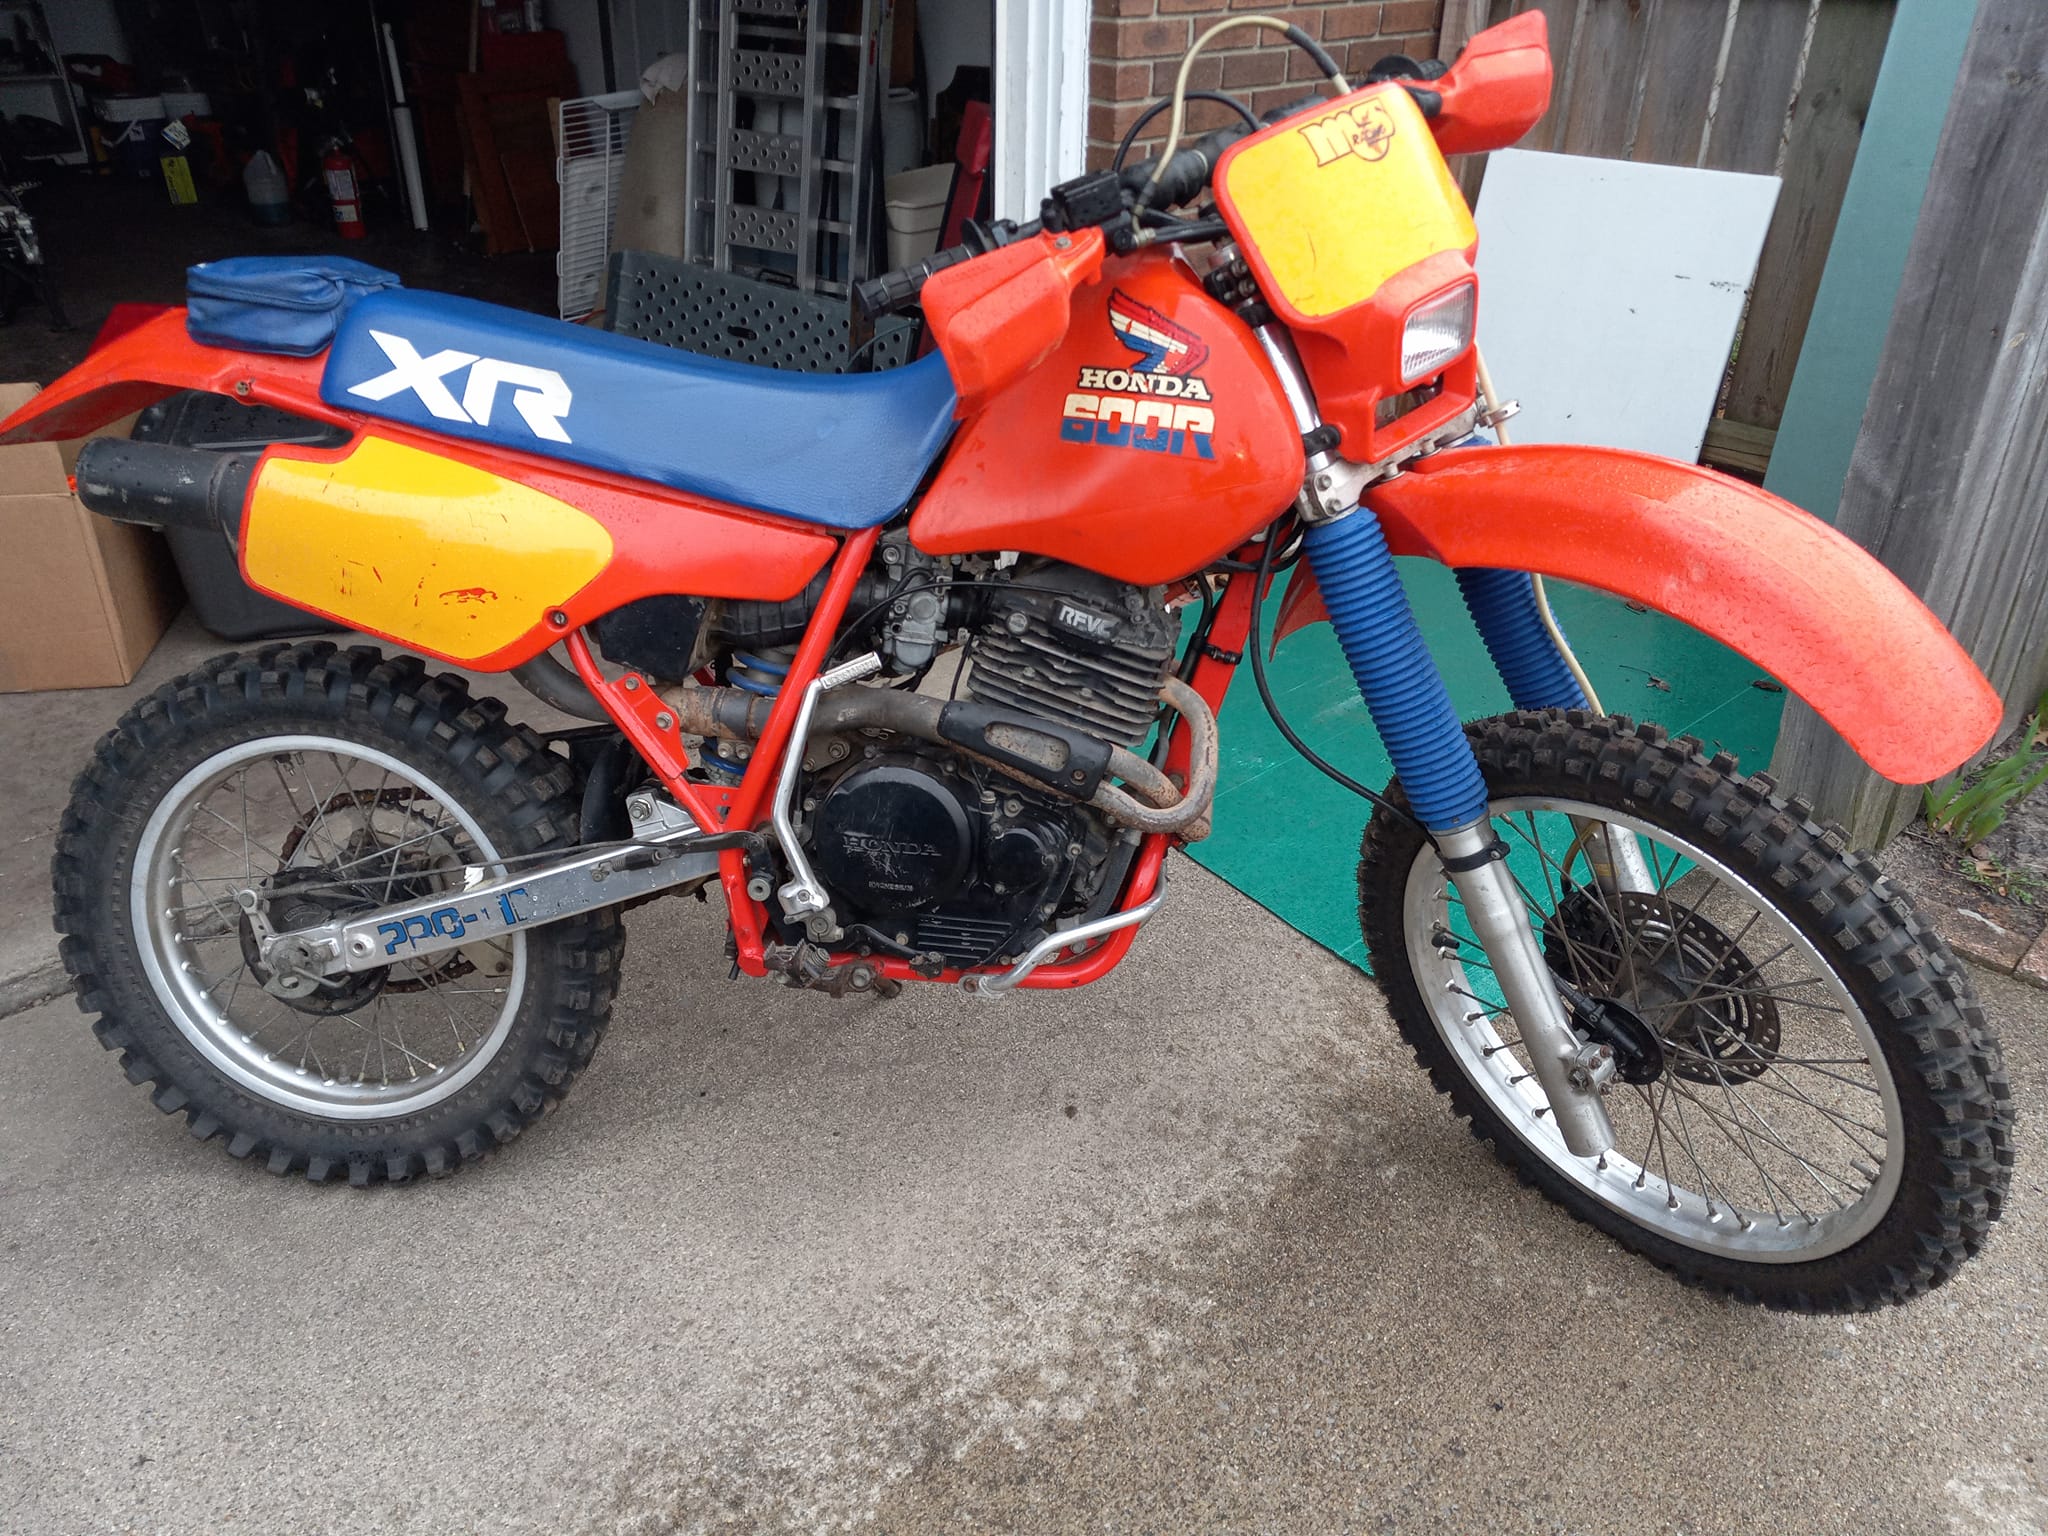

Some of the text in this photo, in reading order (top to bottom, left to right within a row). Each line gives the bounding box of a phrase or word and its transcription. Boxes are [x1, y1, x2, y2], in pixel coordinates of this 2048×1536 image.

[347, 329, 573, 445] XR
[1079, 367, 1213, 402] HONDA
[1060, 393, 1217, 460] 600R
[842, 835, 942, 857] HONDA
